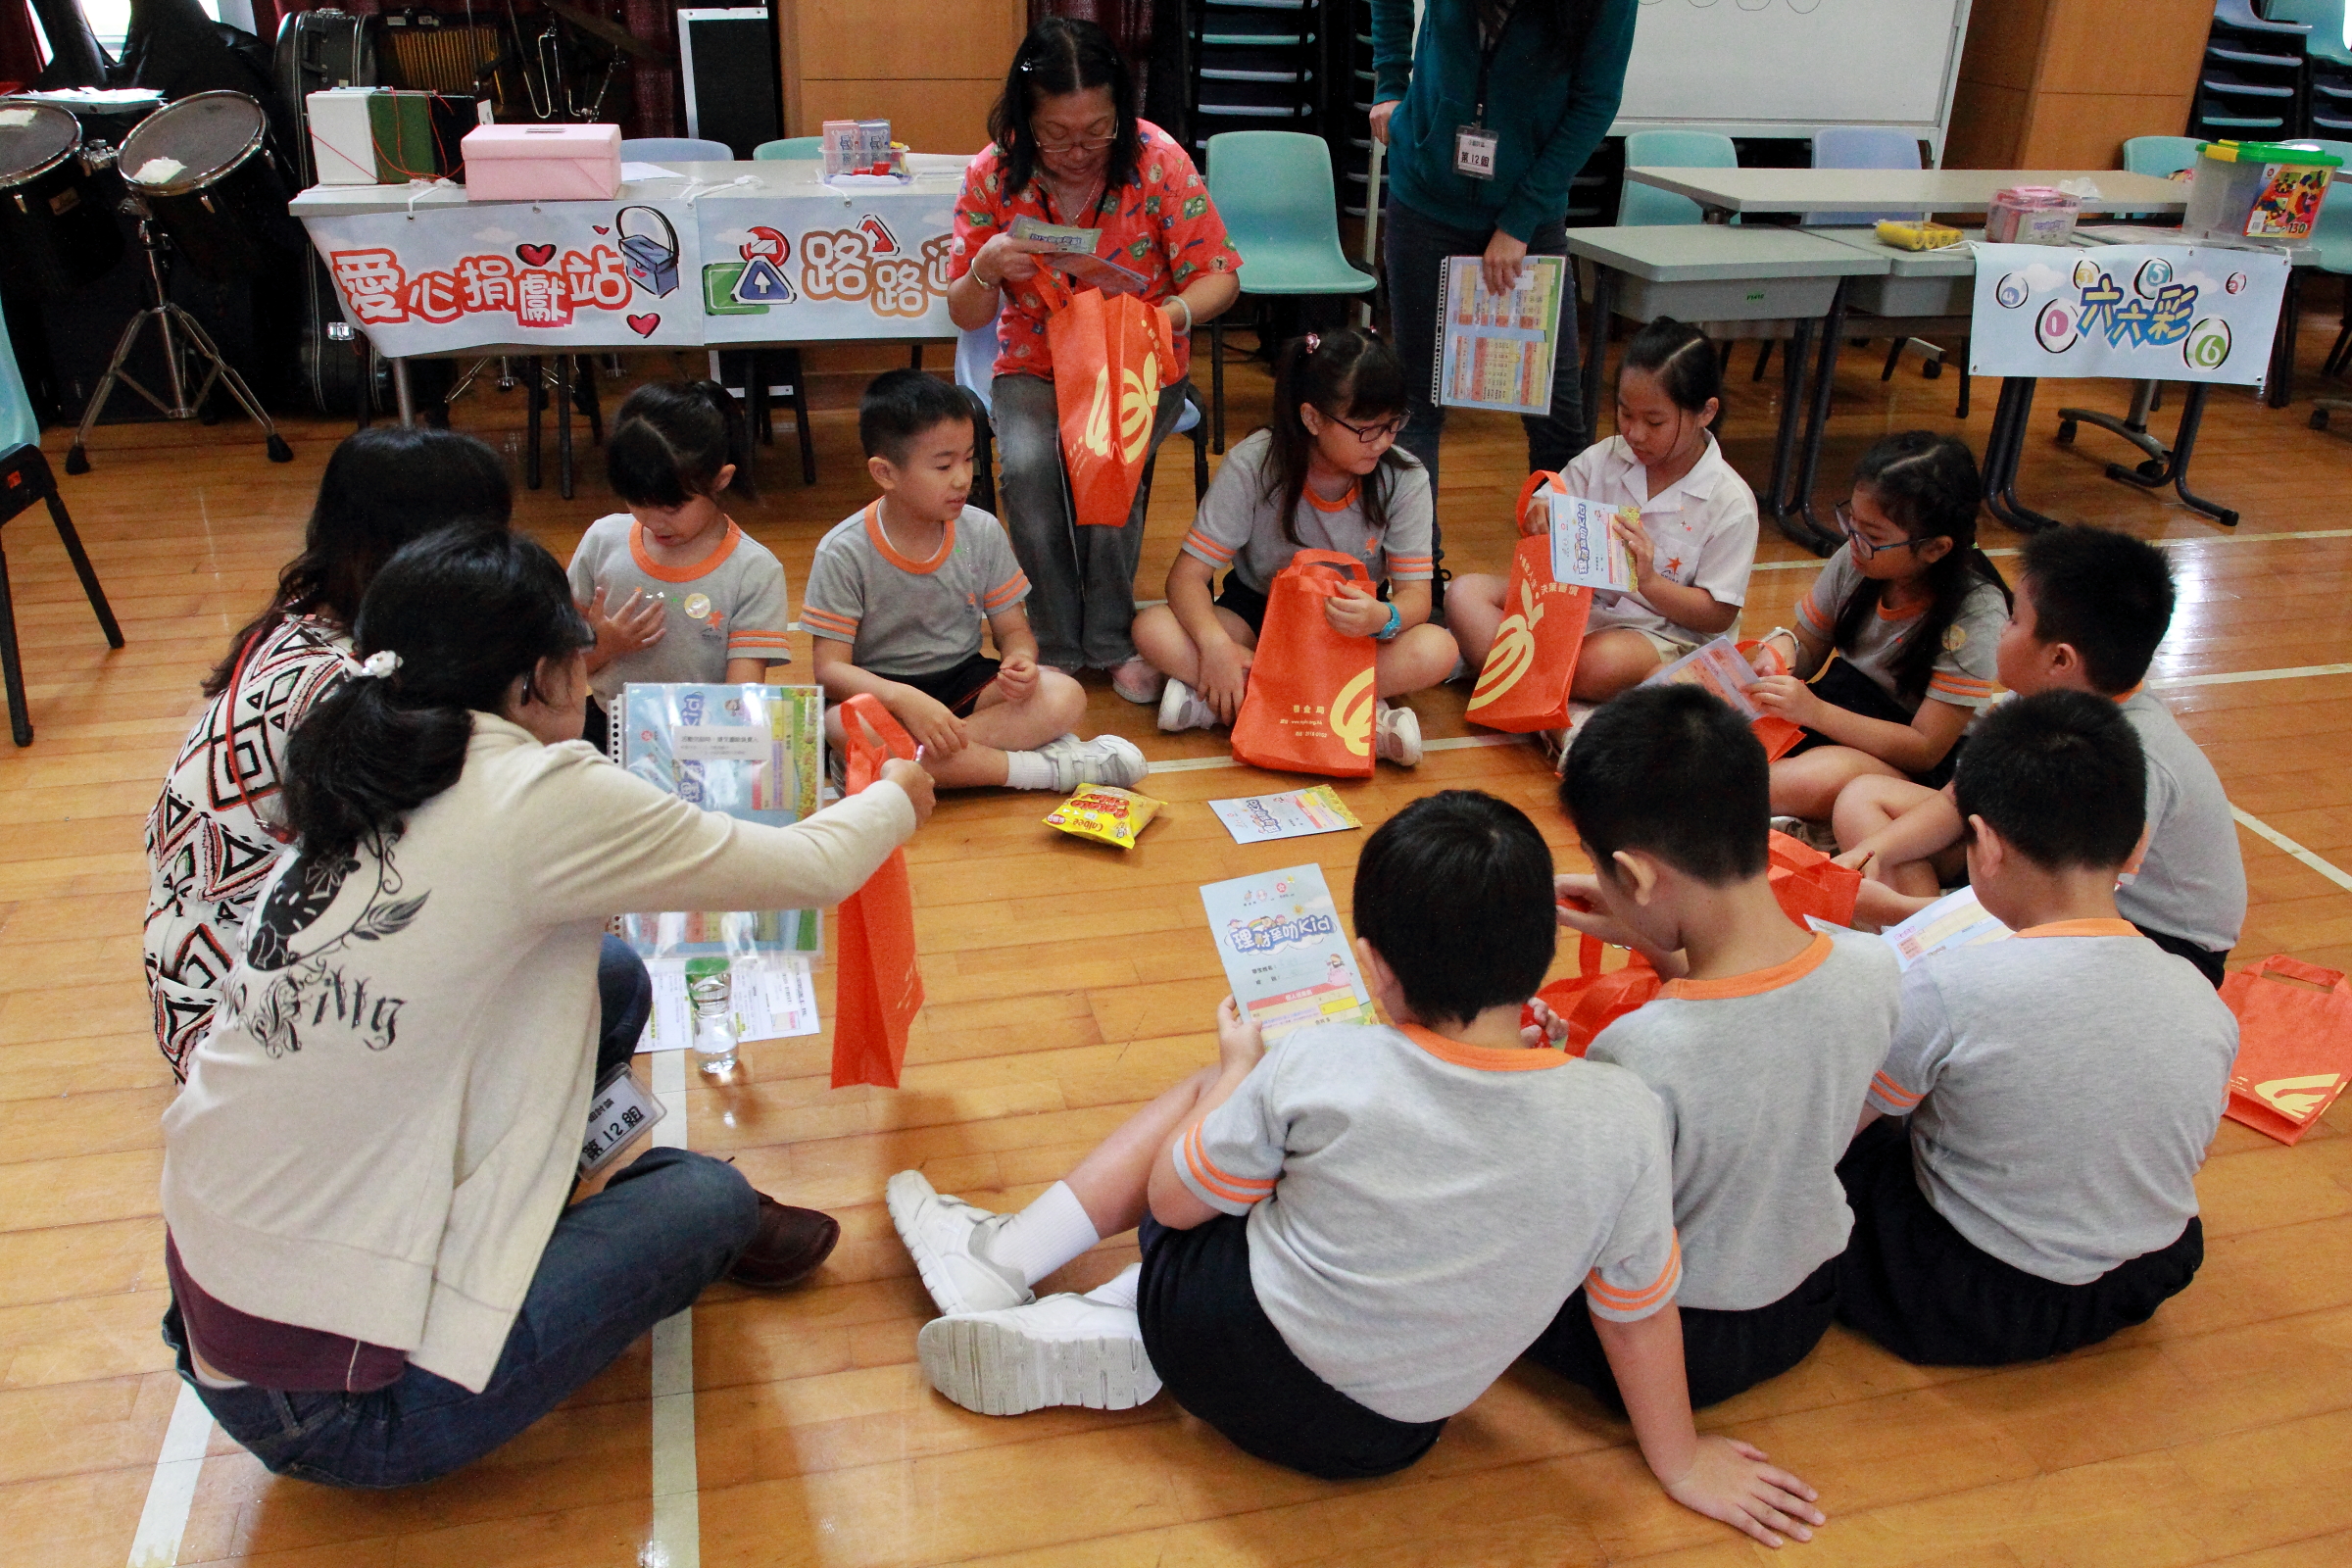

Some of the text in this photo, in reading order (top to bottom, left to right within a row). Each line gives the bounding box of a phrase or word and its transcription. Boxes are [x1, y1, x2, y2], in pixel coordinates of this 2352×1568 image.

[2288, 222, 2307, 234] 130
[336, 244, 627, 322] 愛心捐獻站
[2078, 270, 2090, 285] 3
[2152, 263, 2167, 284] 5
[2003, 288, 2017, 305] 4
[2080, 276, 2196, 343] 六六彩
[2200, 335, 2222, 366] 6
[1073, 819, 1103, 831] Calbee
